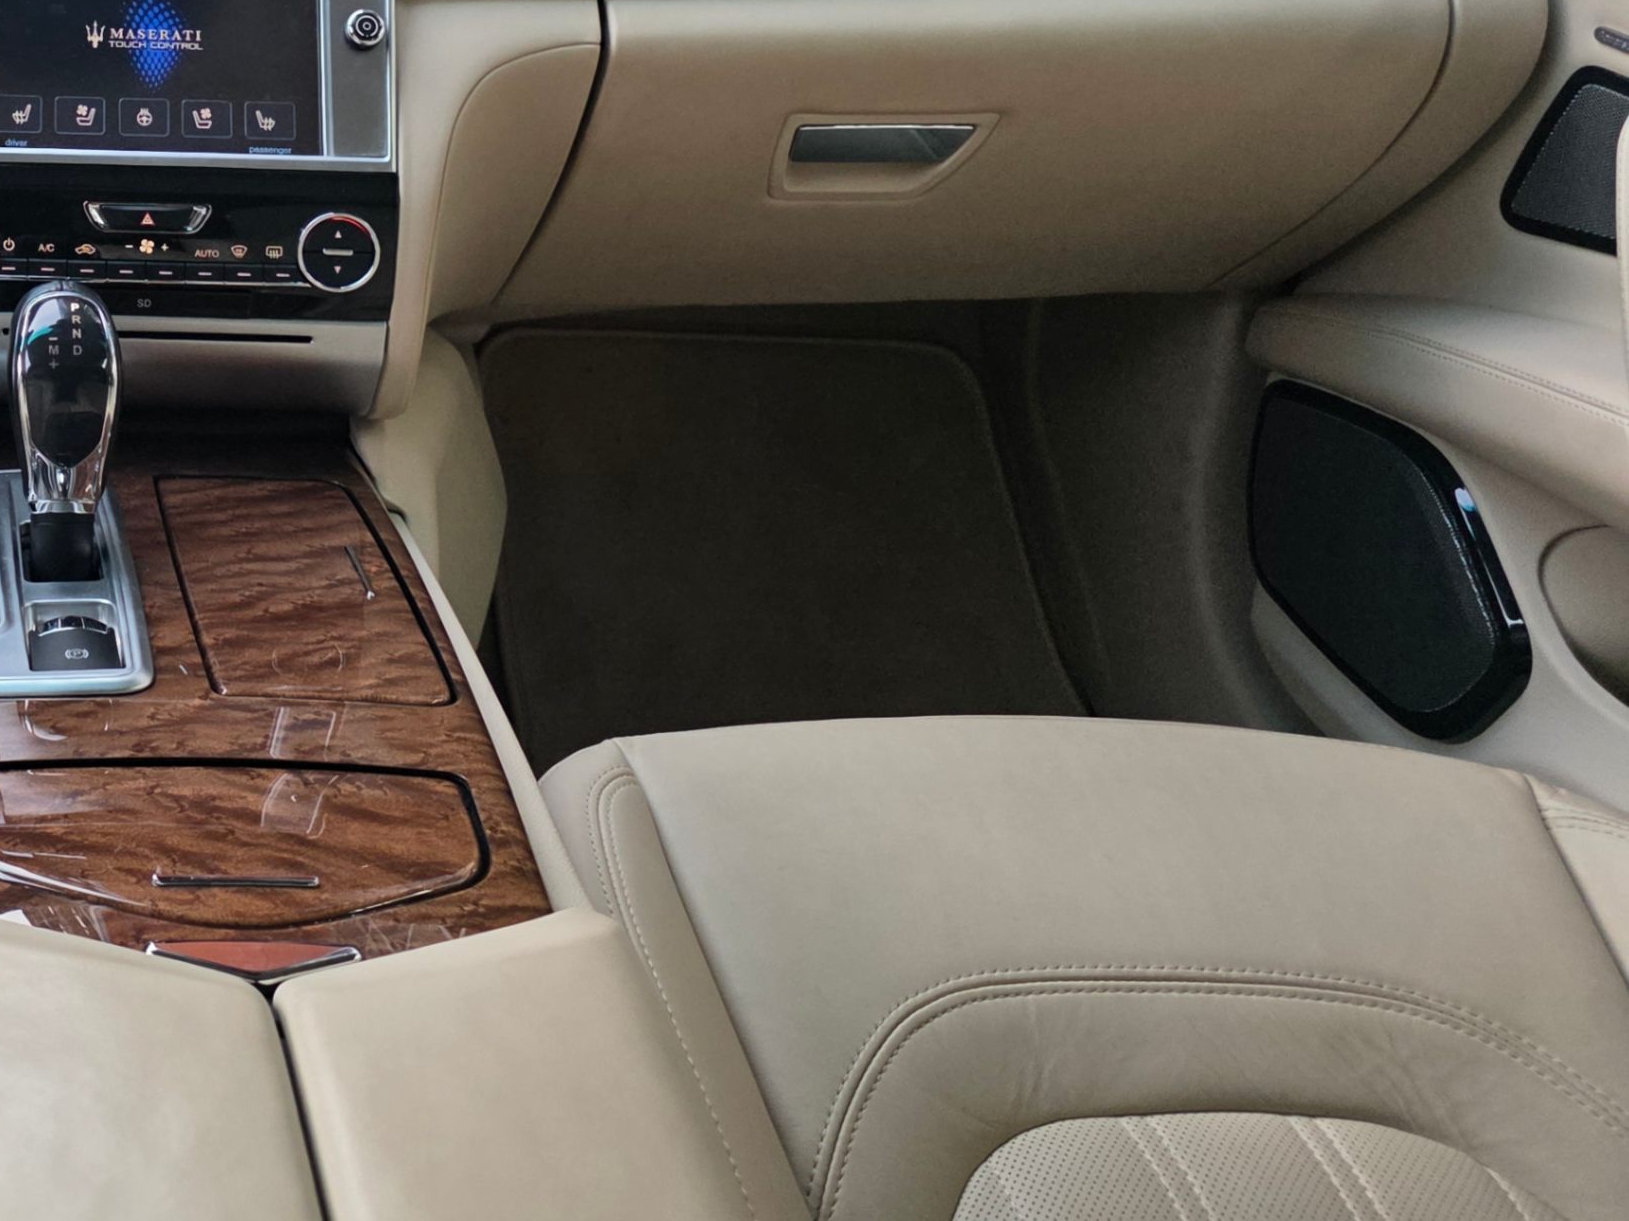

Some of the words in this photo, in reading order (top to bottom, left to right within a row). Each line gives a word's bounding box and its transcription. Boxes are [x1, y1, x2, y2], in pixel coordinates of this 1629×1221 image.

[110, 27, 202, 41] MASERATI
[108, 40, 147, 49] TOUCH
[149, 41, 204, 51] CONTROL
[4, 138, 28, 147] driver
[248, 145, 292, 155] passenger
[38, 243, 55, 253] A/C
[194, 249, 220, 259] AUTO
[70, 302, 80, 312] P
[137, 299, 152, 309] SD
[72, 315, 82, 325] R
[72, 328, 82, 339] N
[48, 345, 60, 355] M
[72, 345, 83, 355] D
